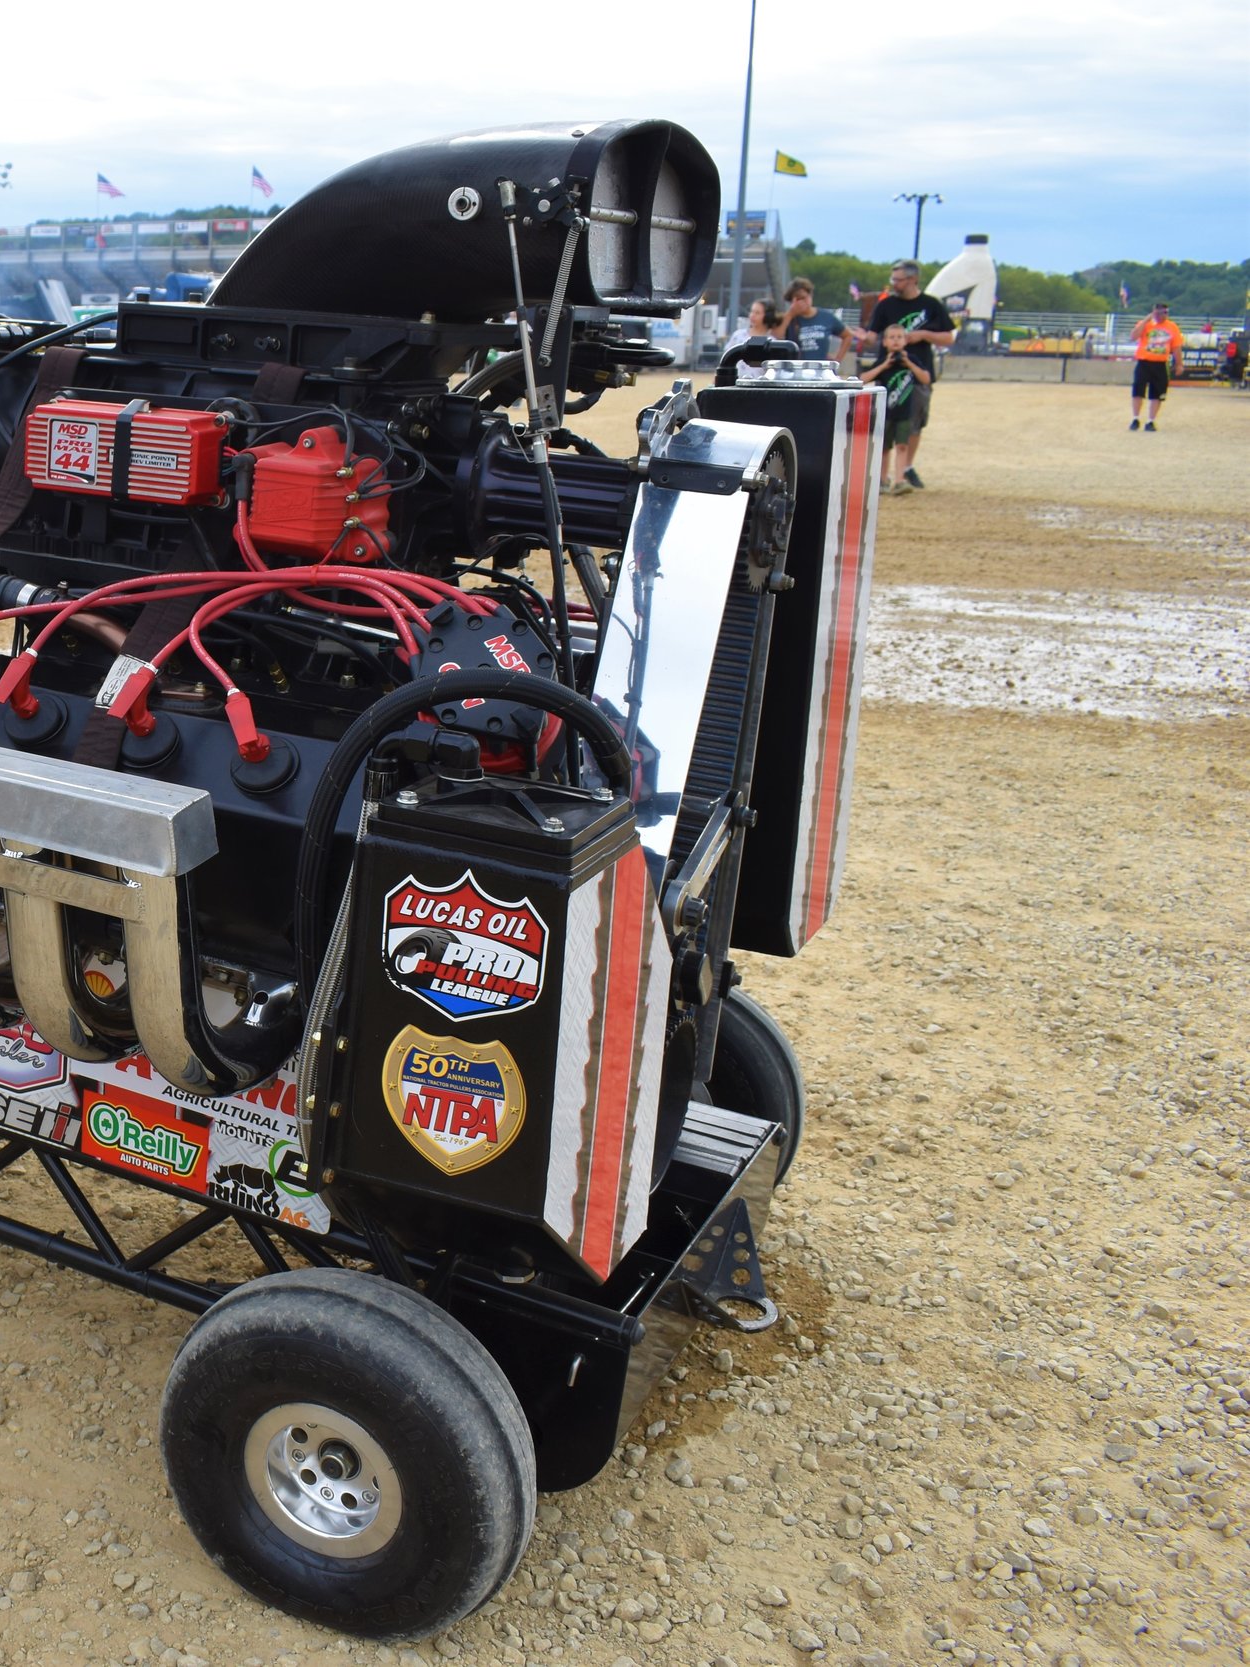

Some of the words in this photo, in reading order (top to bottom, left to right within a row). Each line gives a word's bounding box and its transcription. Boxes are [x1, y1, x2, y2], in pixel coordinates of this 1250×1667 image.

[57, 423, 89, 436] MSD
[53, 444, 93, 454] MAG
[56, 438, 92, 448] PRO
[54, 453, 91, 472] 44
[144, 459, 172, 468] LIMITER
[150, 454, 175, 462] POINTS
[399, 894, 484, 930] LUCAS
[487, 912, 528, 941] OIL
[440, 942, 524, 980] PRO
[414, 958, 539, 1000] PULLING
[430, 978, 510, 1006] LEAGUE
[410, 1052, 471, 1078] 50TH
[402, 1075, 427, 1084] NATIONAL
[427, 1079, 449, 1088] TRACTOR
[449, 1083, 471, 1093] PULLERS
[471, 1088, 504, 1099] ASSOCIATION
[446, 1073, 501, 1089] ANNIVERSARY
[161, 1084, 281, 1133] AGRICULTURAL
[402, 1085, 499, 1143] NTPA
[90, 1104, 199, 1173] O'Reilly
[213, 1121, 276, 1149] MOUNTS
[119, 1153, 142, 1167] AUTO
[142, 1159, 170, 1176] PARTS
[278, 1206, 311, 1229] AG
